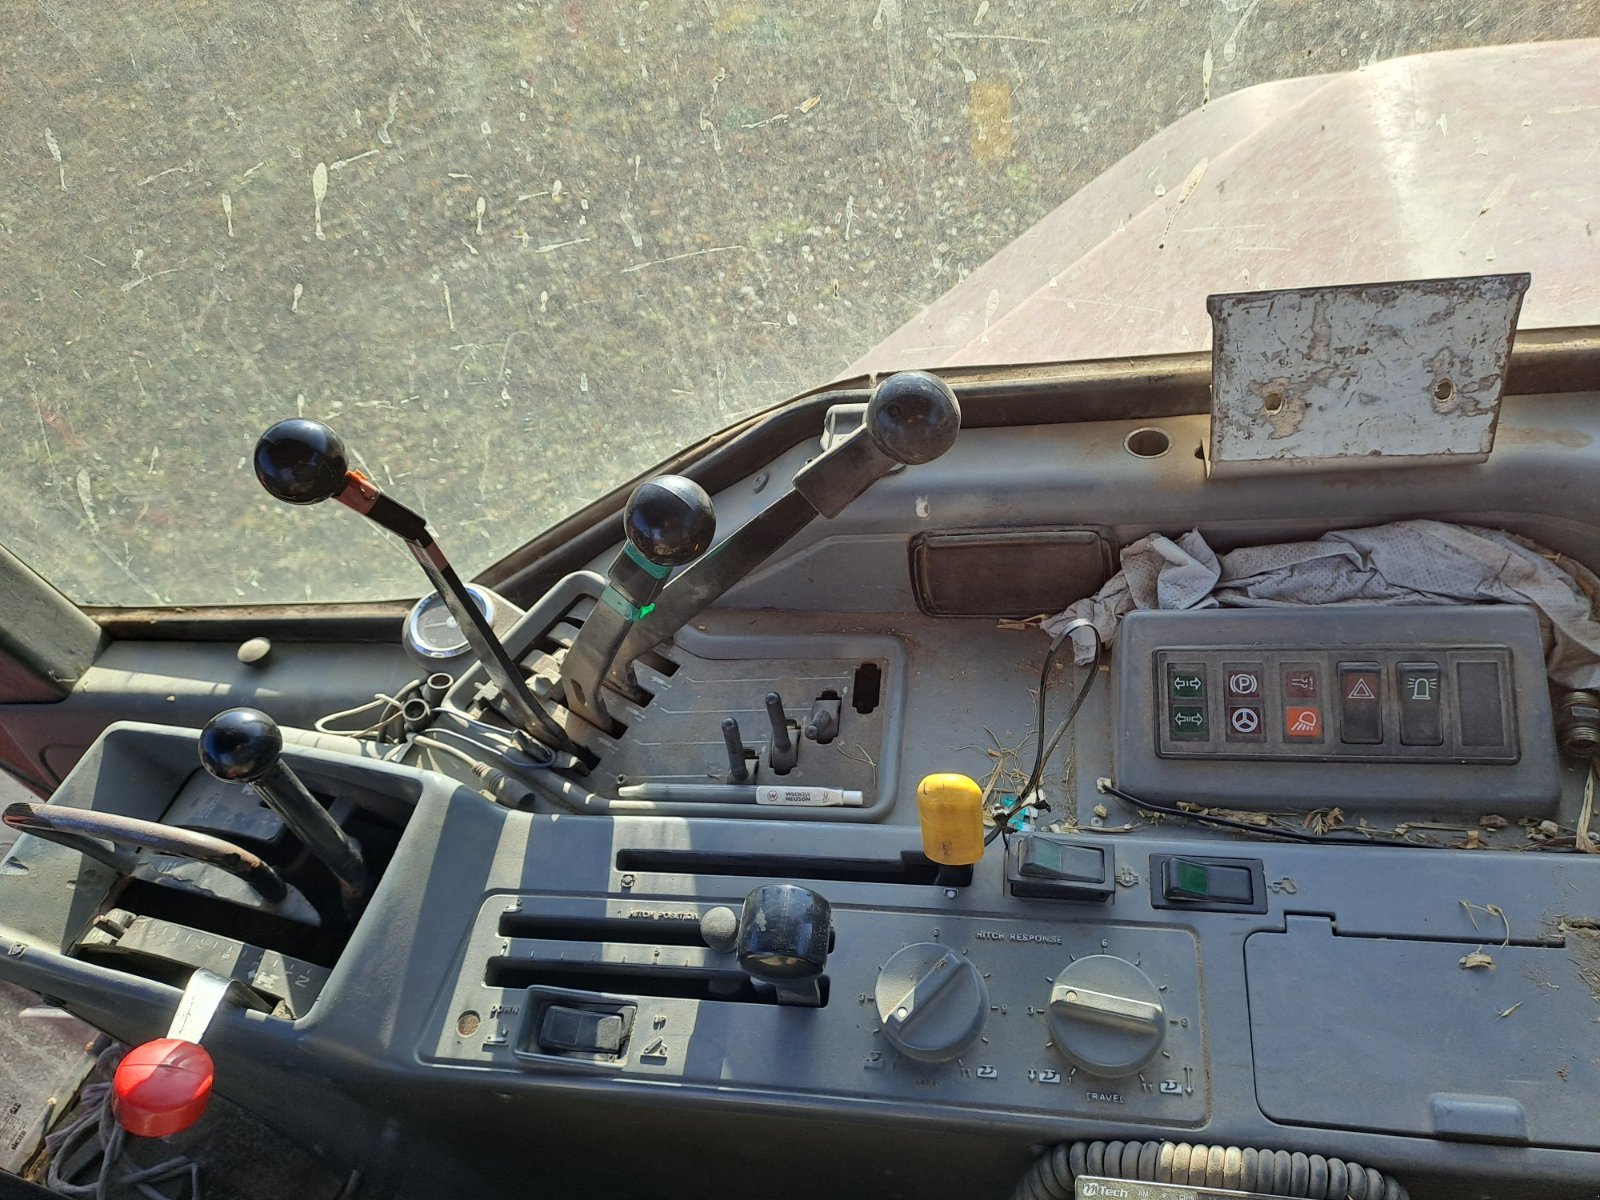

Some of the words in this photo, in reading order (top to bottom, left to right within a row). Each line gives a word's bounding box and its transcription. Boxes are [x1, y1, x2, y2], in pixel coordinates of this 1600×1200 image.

[976, 930, 1005, 941] HITCH
[1009, 932, 1064, 945] RESPONSE
[1101, 939, 1108, 948] 6
[490, 1004, 519, 1016] DOWN
[1027, 1005, 1034, 1016] 3
[1086, 1092, 1126, 1104] TRAVEL
